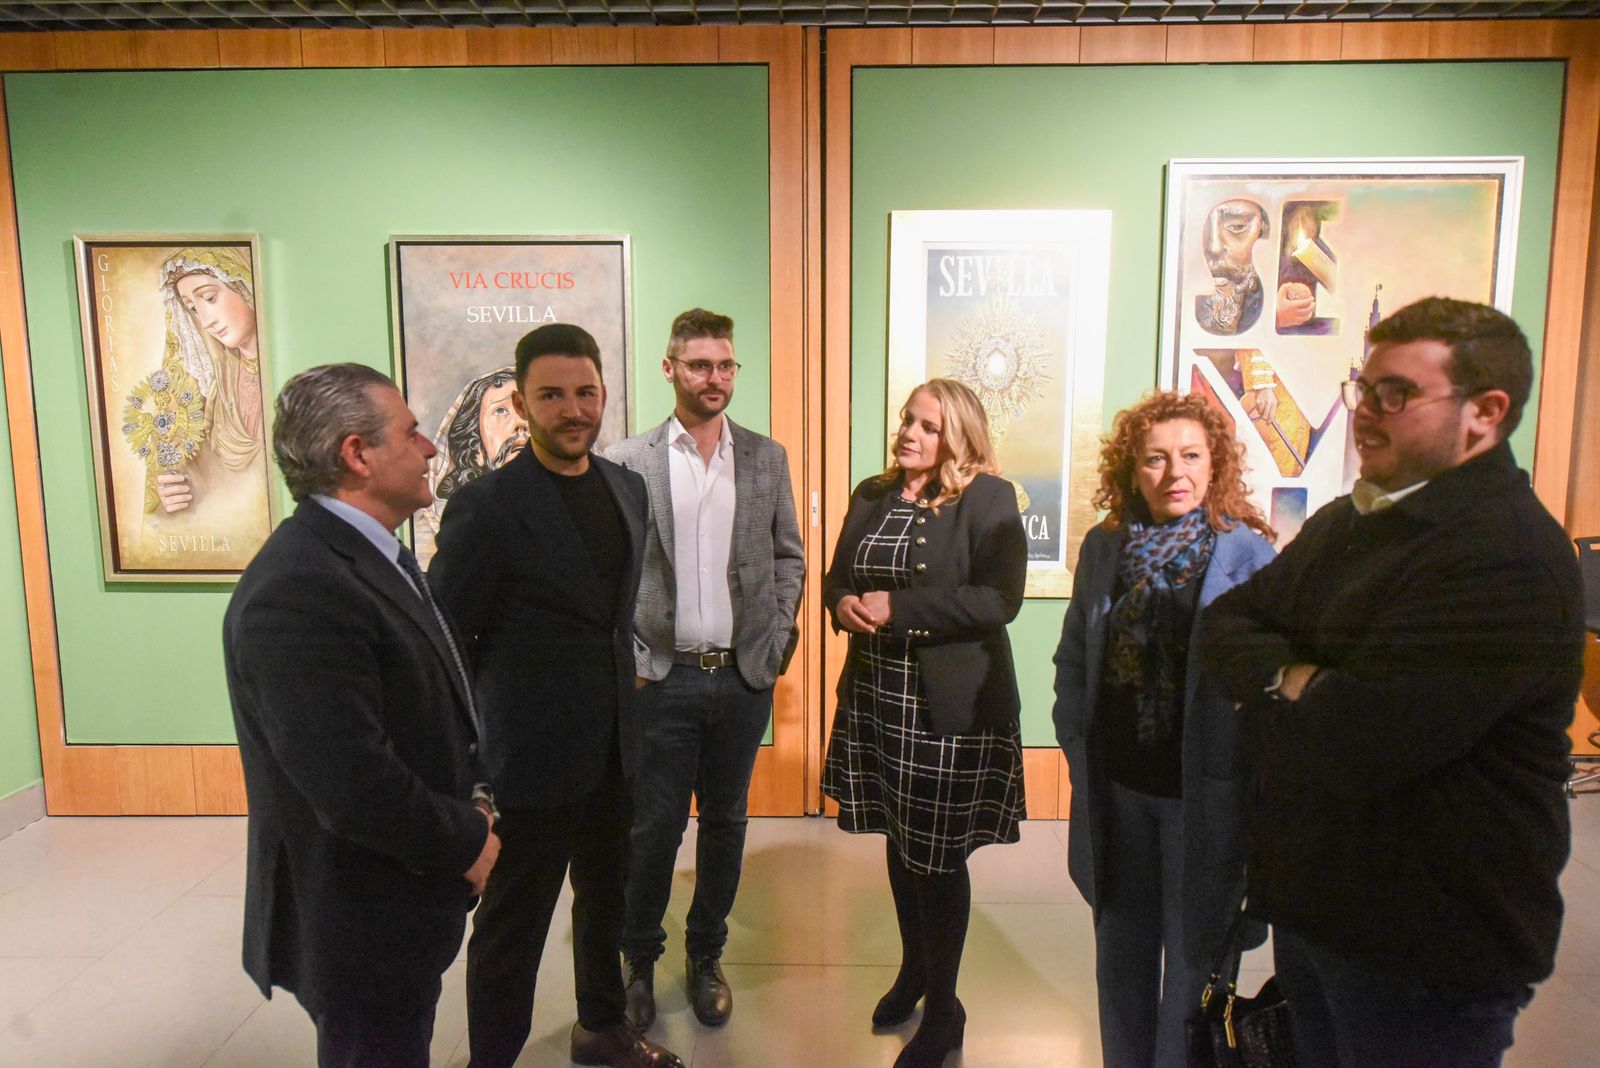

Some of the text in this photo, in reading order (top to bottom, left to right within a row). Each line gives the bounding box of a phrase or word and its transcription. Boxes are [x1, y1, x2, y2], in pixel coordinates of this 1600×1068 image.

[449, 271, 575, 289] VIA CRUCIS
[466, 305, 557, 322] SEVILLA
[98, 254, 119, 392] GLORIAS
[159, 535, 232, 552] SEVILLA
